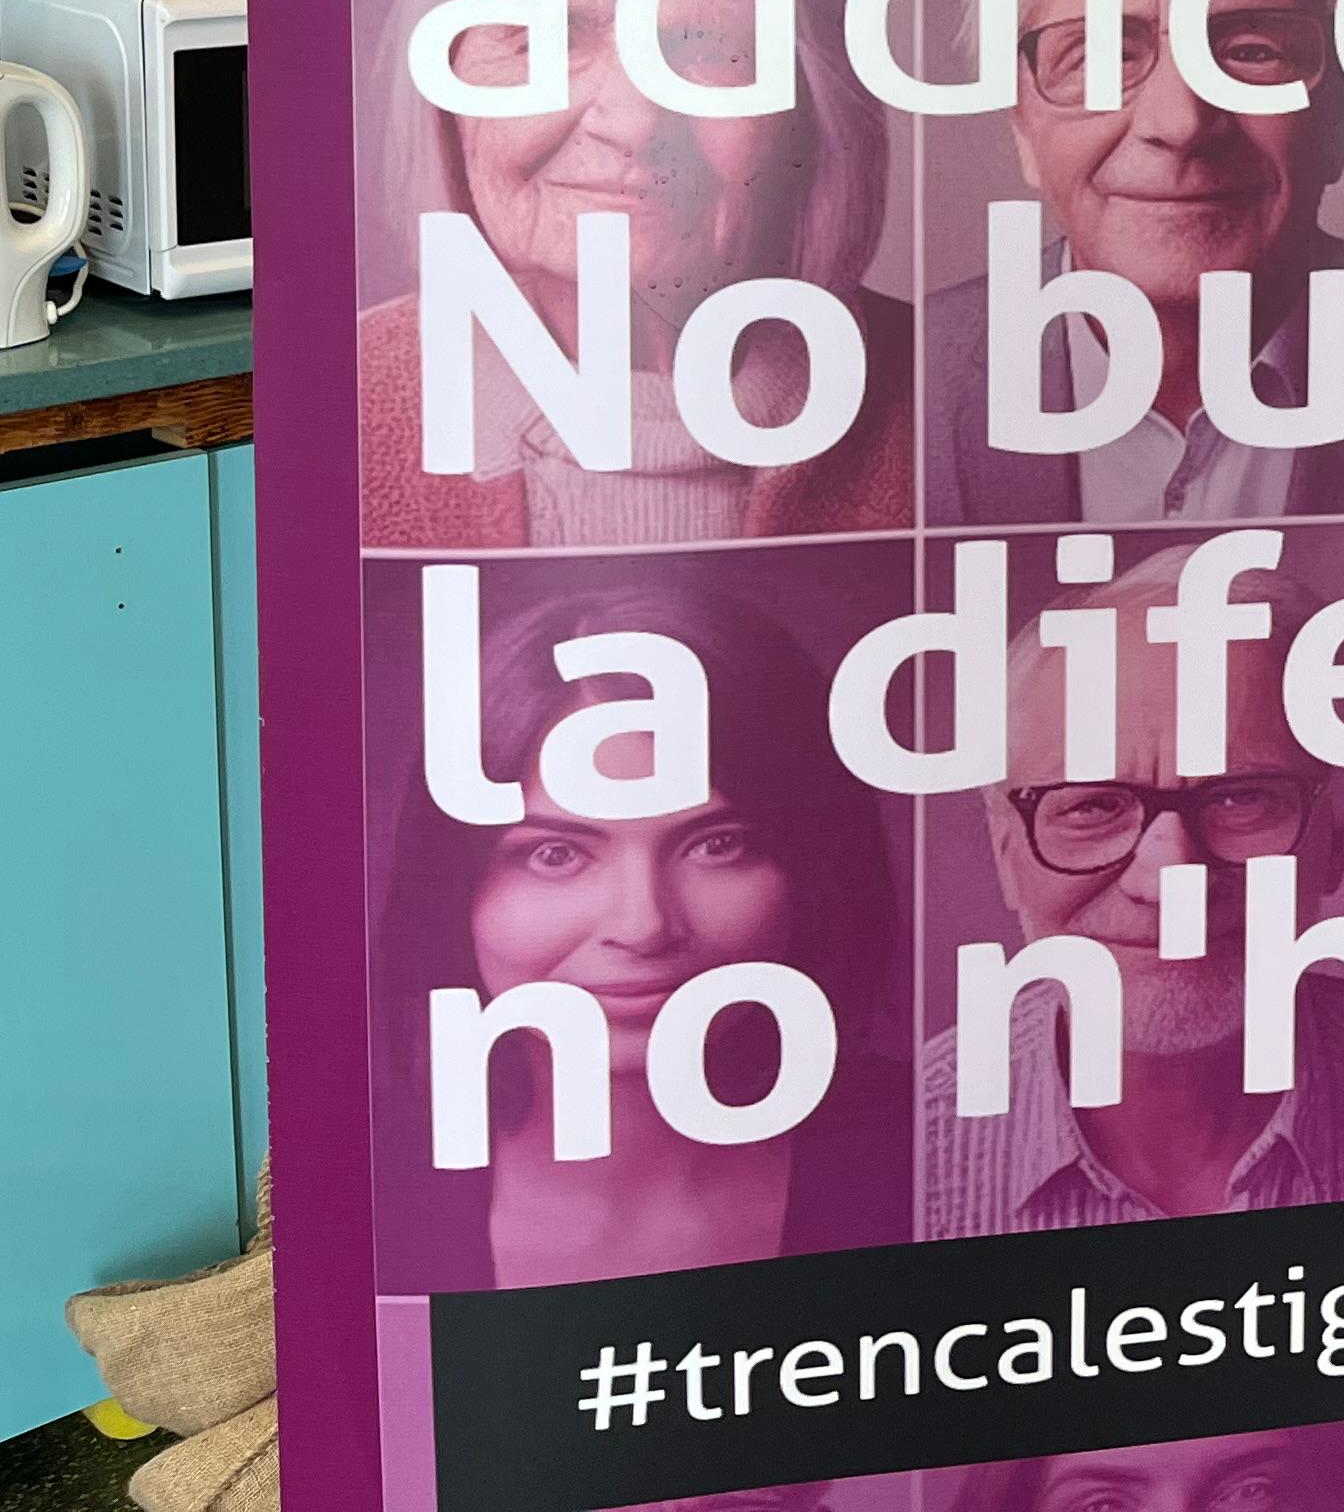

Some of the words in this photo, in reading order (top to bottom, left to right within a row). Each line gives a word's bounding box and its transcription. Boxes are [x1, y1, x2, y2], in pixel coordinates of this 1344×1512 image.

[419, 210, 866, 474] No
[421, 564, 710, 824] la
[429, 961, 838, 1170] no
